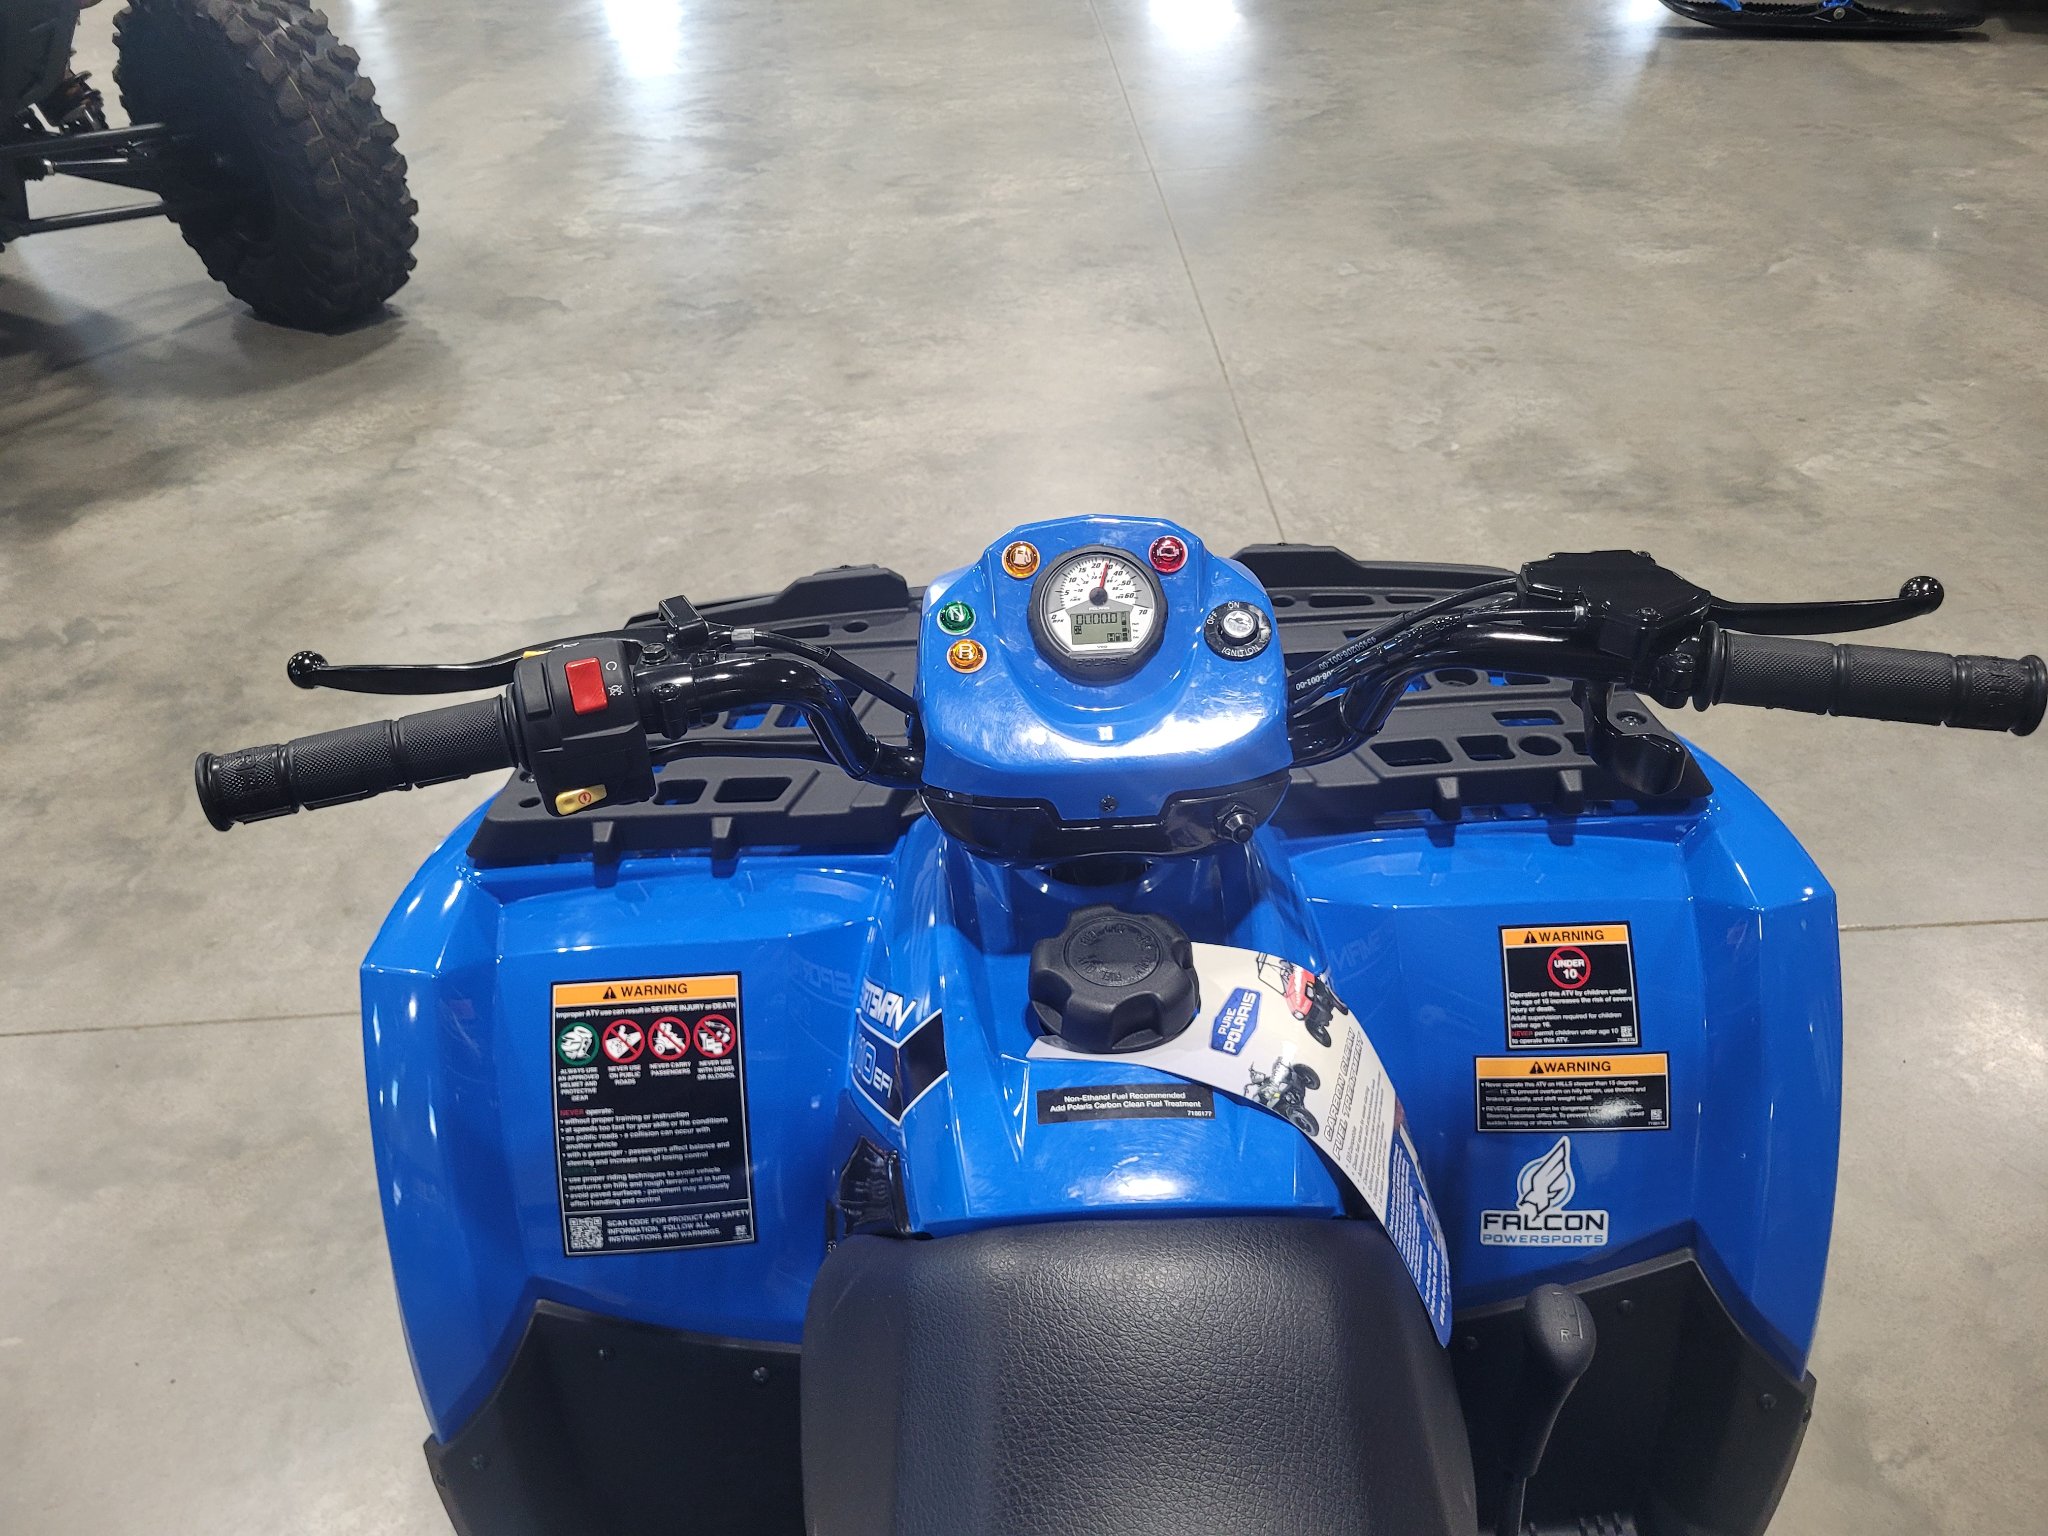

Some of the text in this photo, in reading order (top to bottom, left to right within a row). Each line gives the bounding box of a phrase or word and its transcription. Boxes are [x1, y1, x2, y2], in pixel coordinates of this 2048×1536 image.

[1228, 600, 1240, 608] ON
[948, 605, 964, 622] N
[1206, 611, 1218, 625] OFF
[958, 644, 974, 659] R
[1222, 645, 1261, 658] IGNITION
[1538, 930, 1604, 942] WARNING
[1554, 958, 1585, 968] UNDER
[1562, 968, 1578, 980] 10
[621, 983, 688, 997] WARNING
[1218, 1008, 1236, 1035] PURE
[1223, 992, 1257, 1053] POLARIS
[1544, 1061, 1612, 1073] WARNING
[873, 1066, 892, 1098] EFI
[1064, 1094, 1110, 1103] Non-Ethanol
[1050, 1104, 1066, 1113] Add
[1324, 1073, 1345, 1142] CARBON
[1333, 1119, 1348, 1160] FUEL
[650, 1216, 666, 1224] FOR
[667, 1214, 703, 1223] PRODUCT
[704, 1212, 720, 1220] AND
[721, 1209, 749, 1218] SAFETY
[1483, 1213, 1604, 1231] FALCON
[662, 1222, 694, 1231] FOLLOW
[608, 1233, 662, 1243] INSTRUCTIONS
[1482, 1234, 1603, 1244] POWERSPORTS
[1560, 1328, 1570, 1342] R
